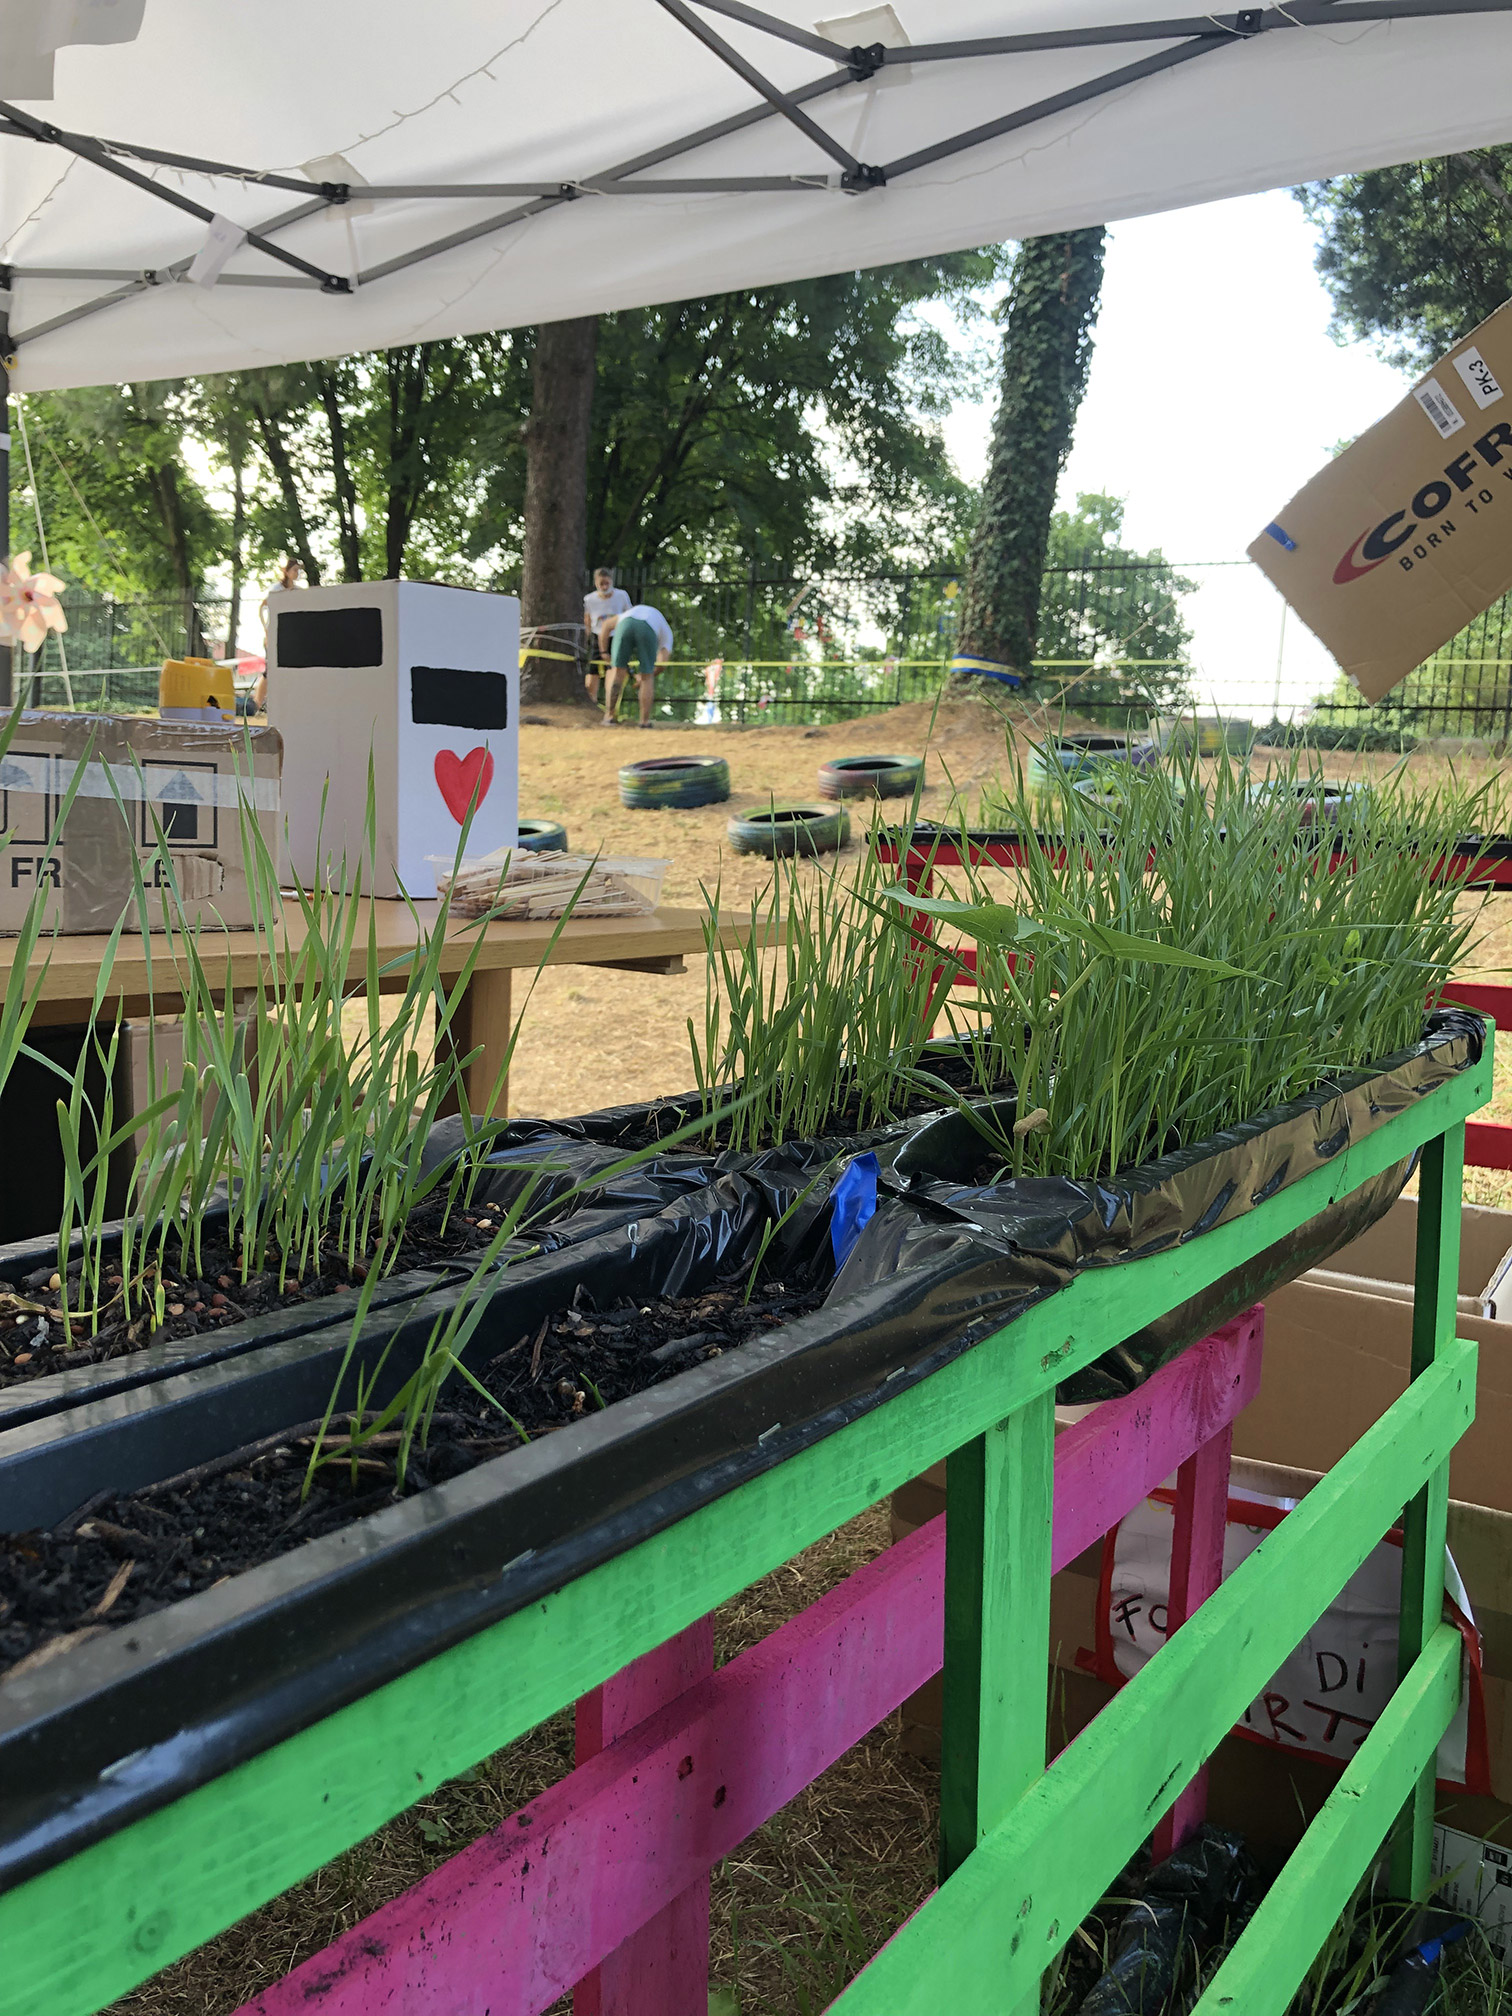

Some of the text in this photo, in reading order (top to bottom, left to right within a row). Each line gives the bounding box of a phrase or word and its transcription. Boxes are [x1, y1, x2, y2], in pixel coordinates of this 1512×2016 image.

[1468, 360, 1499, 396] PK-3
[1398, 488, 1494, 573] BORN TO
